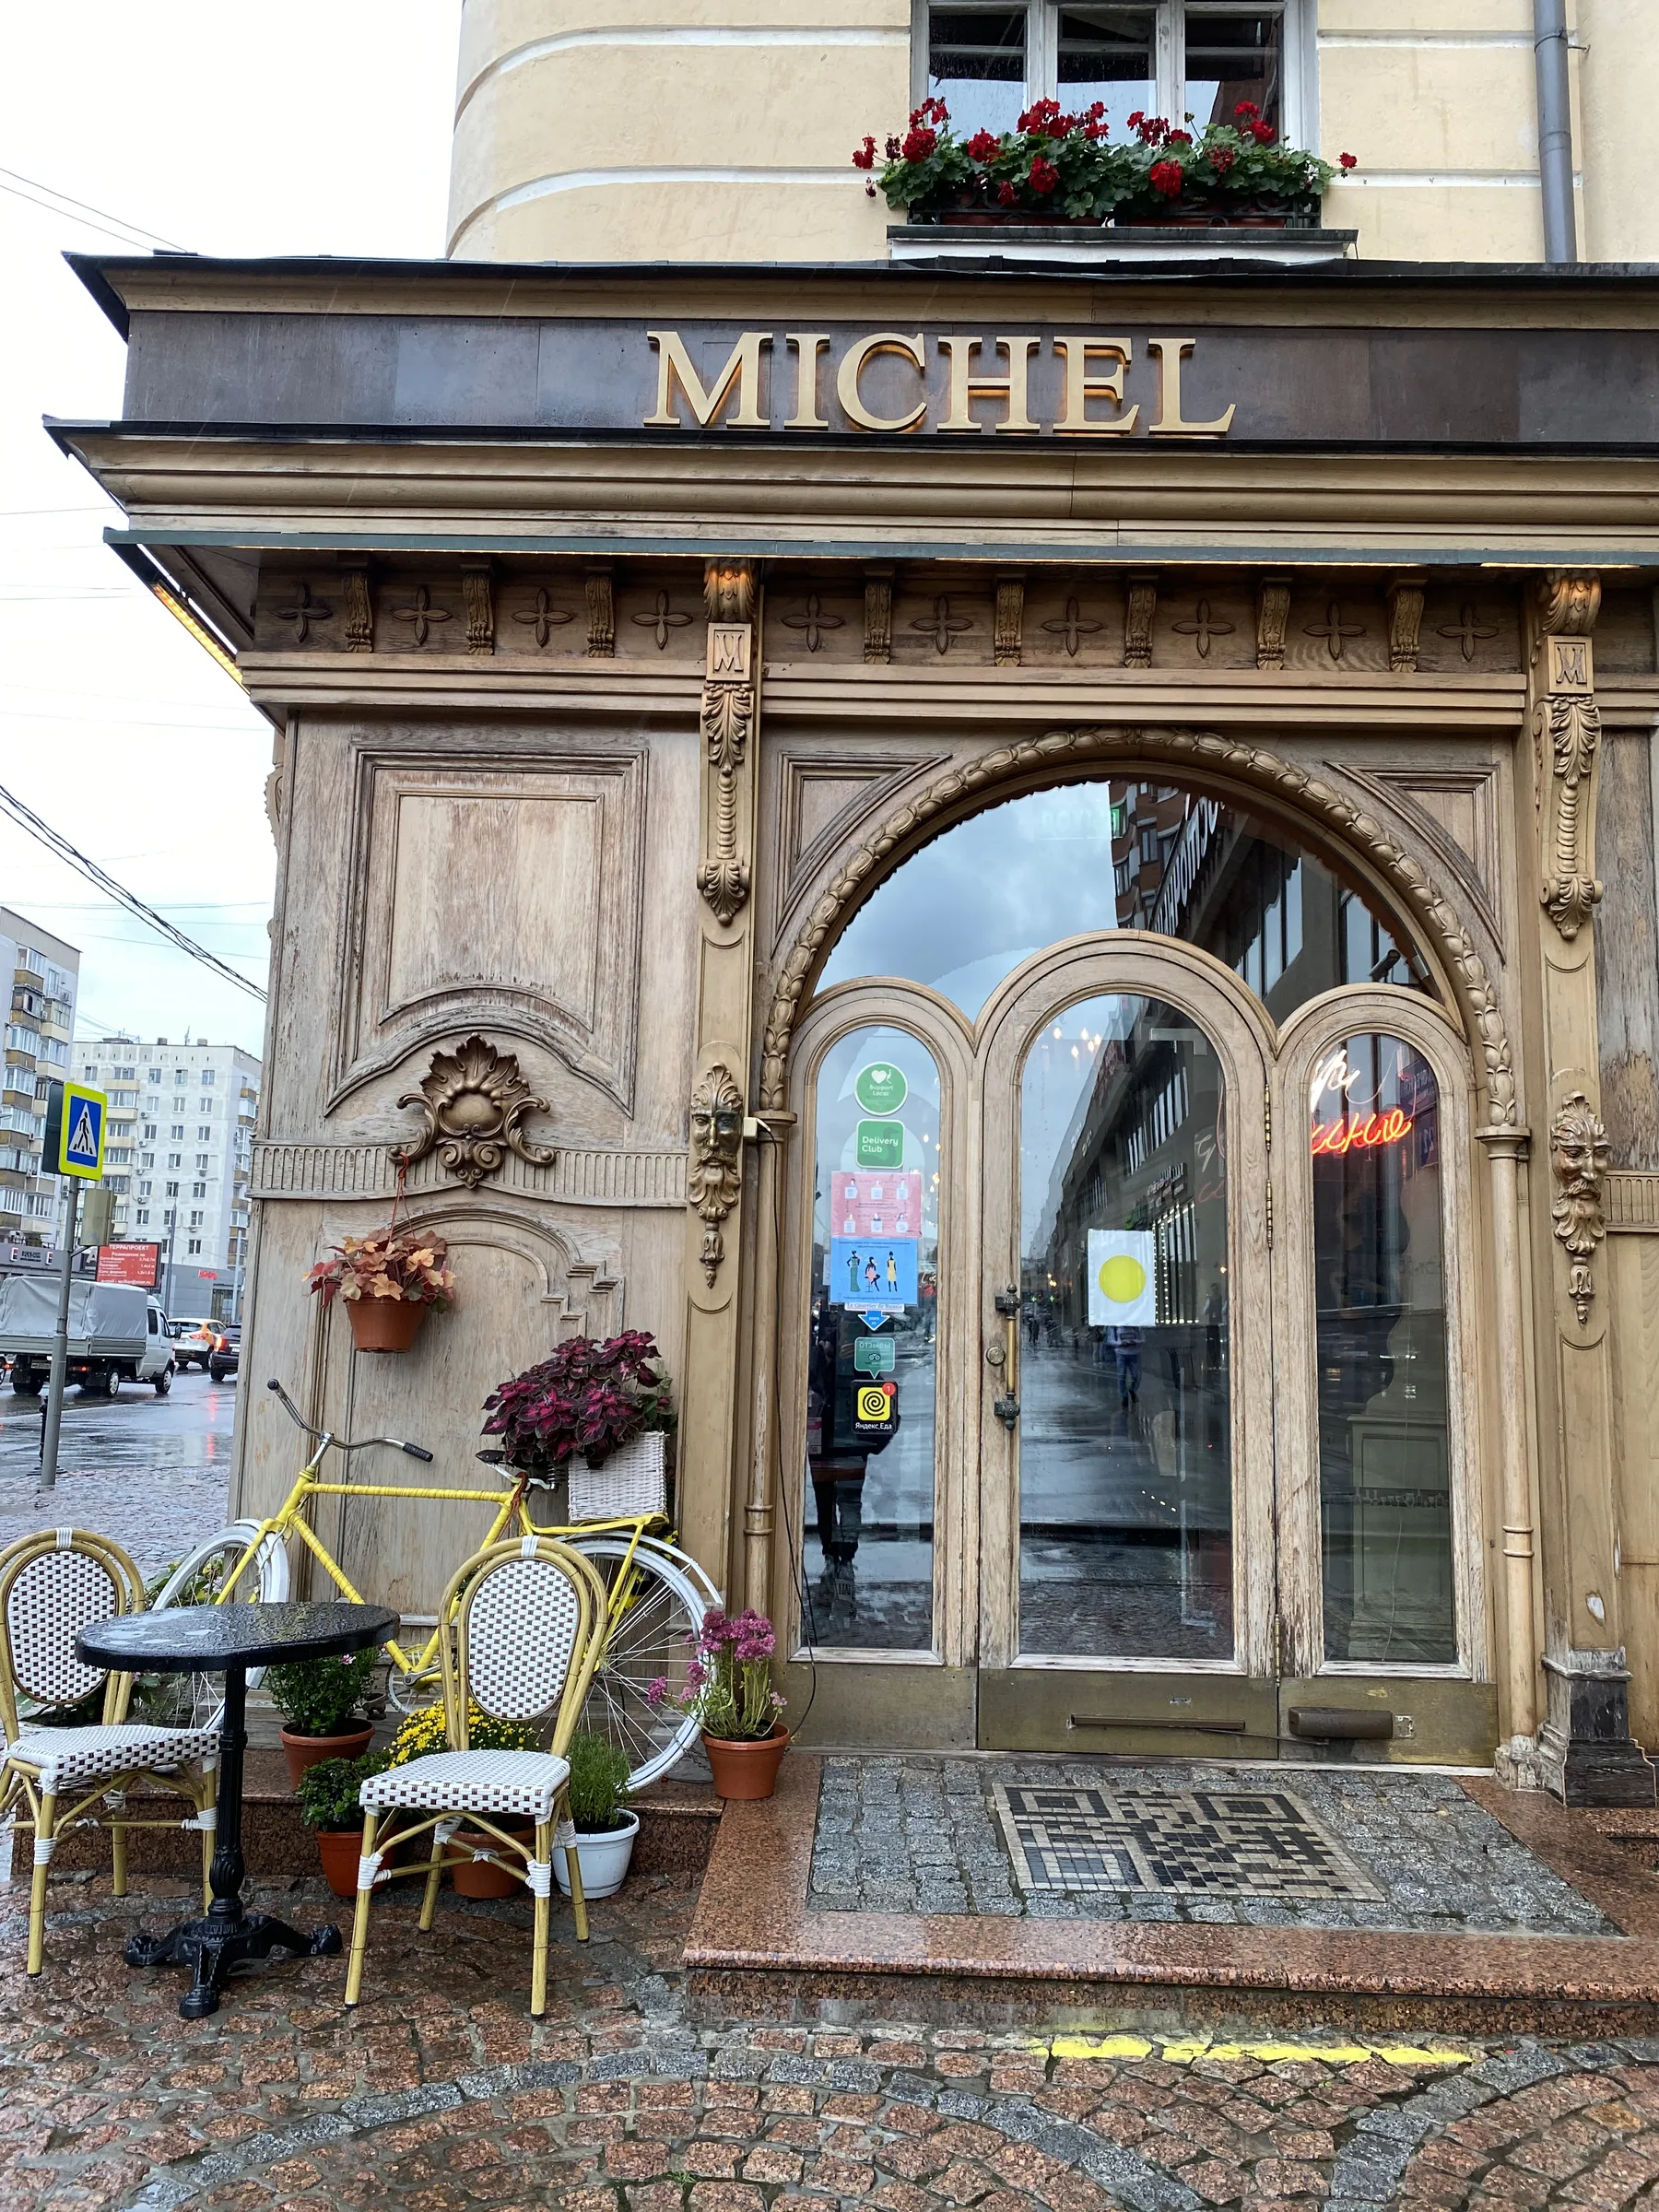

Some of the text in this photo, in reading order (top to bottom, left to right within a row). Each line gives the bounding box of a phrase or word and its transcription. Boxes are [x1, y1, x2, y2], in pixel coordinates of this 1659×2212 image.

[643, 330, 1236, 436] MICHEL
[714, 633, 745, 672] M
[1556, 646, 1587, 685] M
[863, 1136, 899, 1147] Delivery
